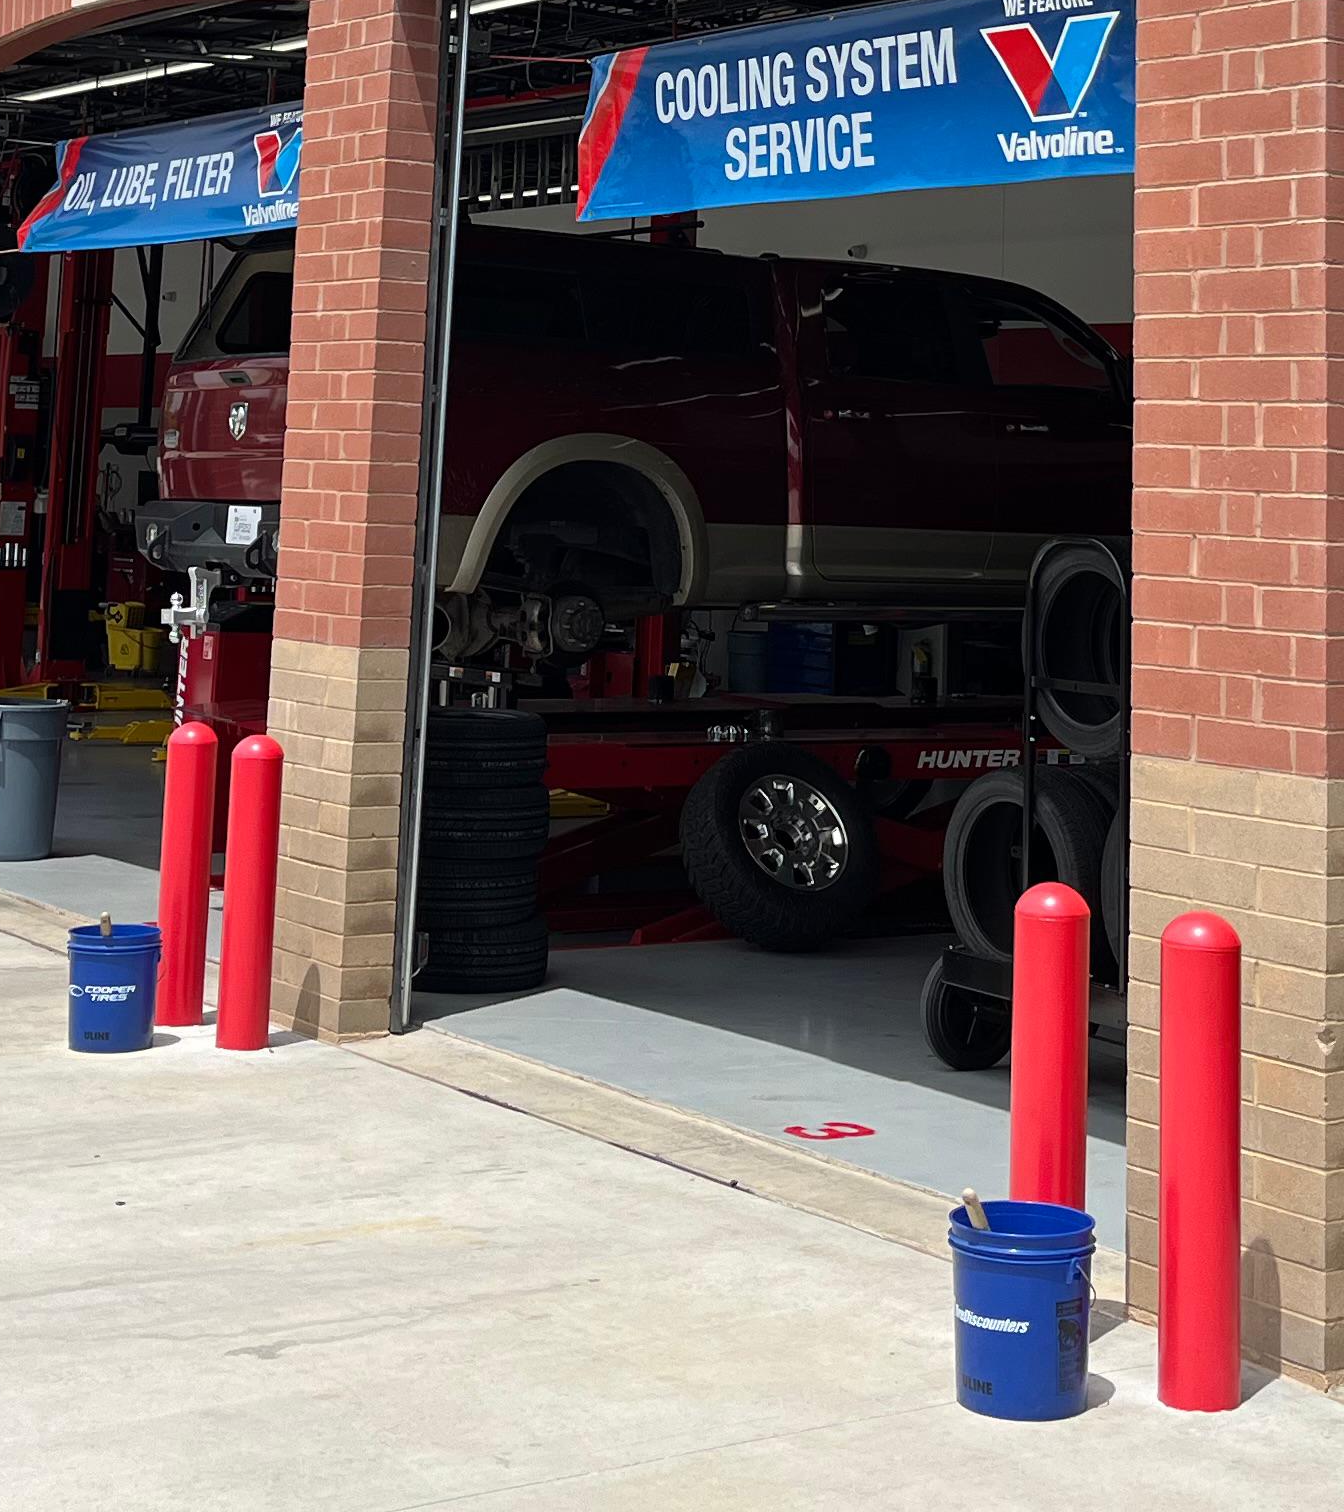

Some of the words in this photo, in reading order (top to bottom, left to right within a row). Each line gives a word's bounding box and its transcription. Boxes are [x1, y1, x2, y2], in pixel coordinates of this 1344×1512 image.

[655, 51, 795, 124] COOLING
[805, 27, 957, 103] SYSTEM
[724, 113, 875, 180] SERVICE
[997, 126, 1114, 162] Valvoline
[100, 162, 159, 211] LUBE,
[162, 151, 234, 201] FILTER
[917, 749, 1020, 769] HUNTER
[84, 985, 136, 994] COOPER
[90, 993, 128, 1001] TIRES
[962, 1374, 993, 1396] ULINE
